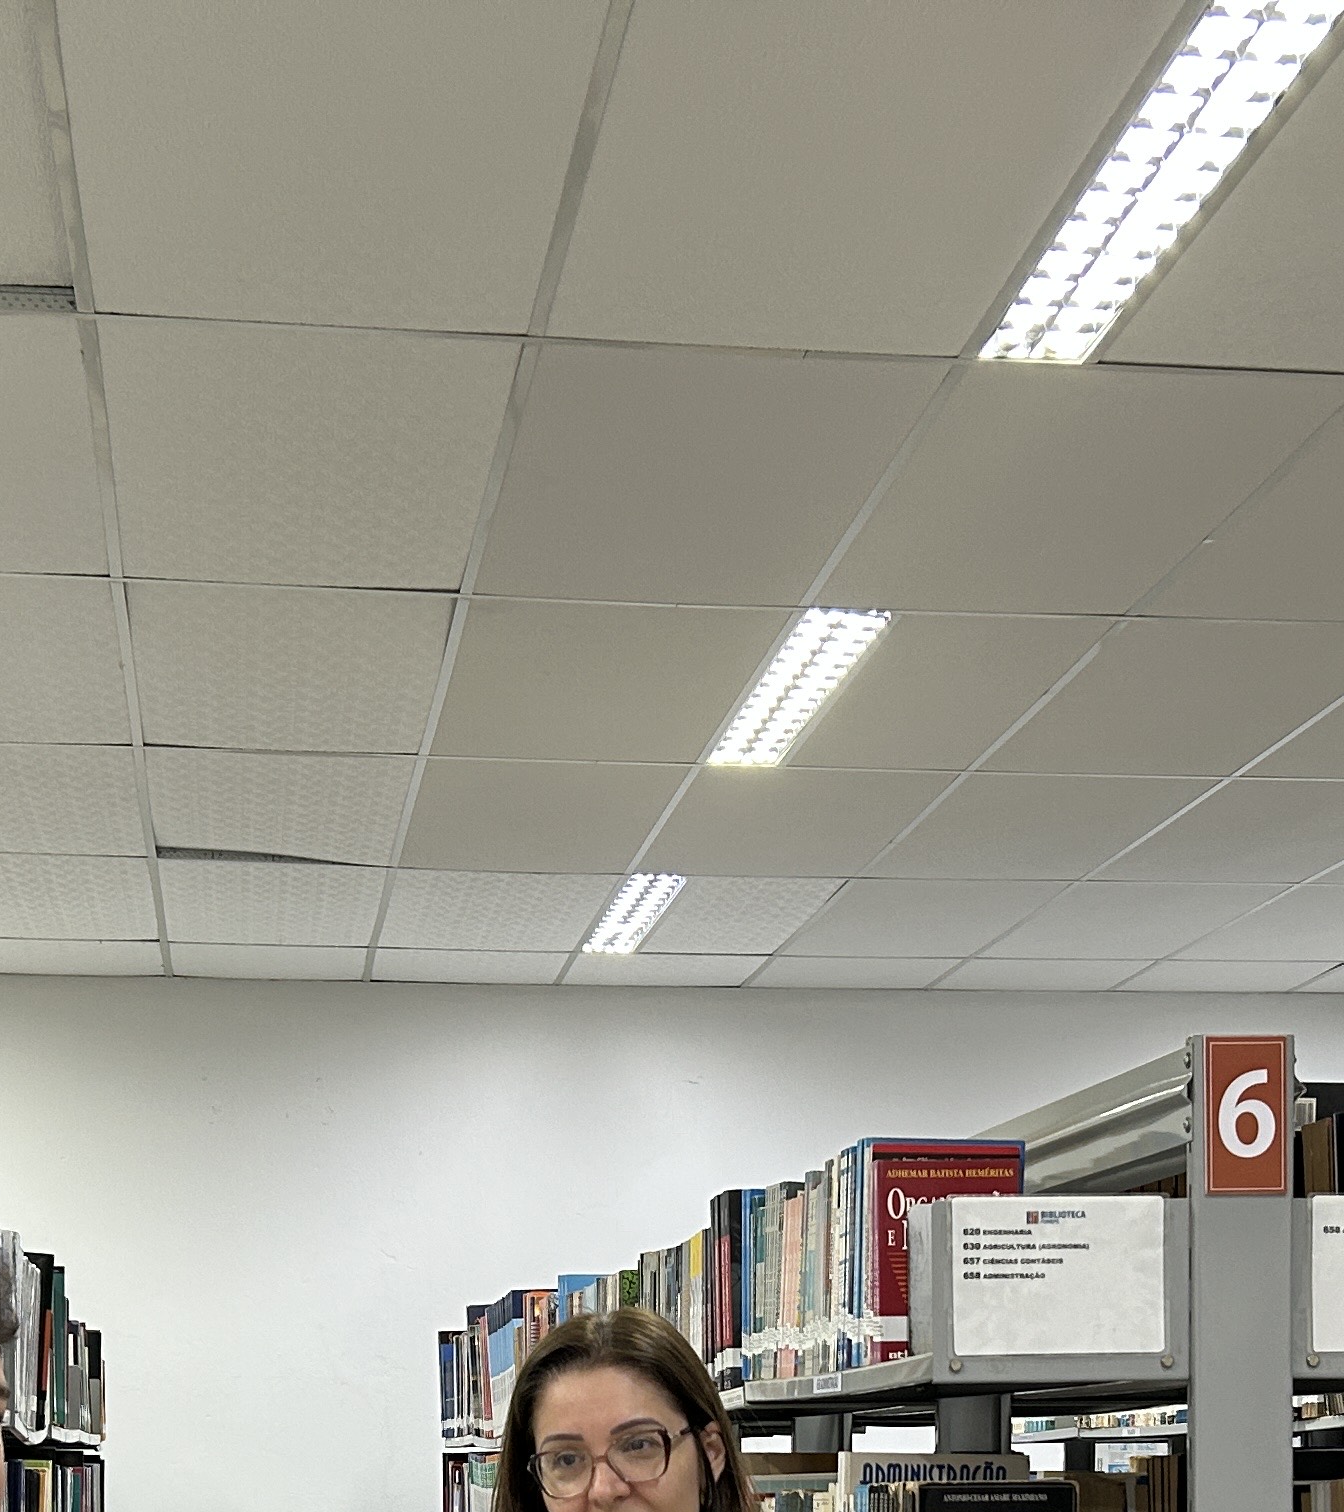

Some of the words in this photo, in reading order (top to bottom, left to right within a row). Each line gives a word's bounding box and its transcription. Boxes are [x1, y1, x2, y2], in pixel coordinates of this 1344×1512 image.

[1218, 1067, 1277, 1158] 6
[930, 1168, 964, 1178] BATISTA
[1040, 1210, 1086, 1219] BIBLIOTECA
[887, 1229, 896, 1246] E
[983, 1243, 1036, 1251] AGRICULTURA
[983, 1271, 1045, 1280] ADMINISTRAÇÃO
[888, 1349, 908, 1359] atl
